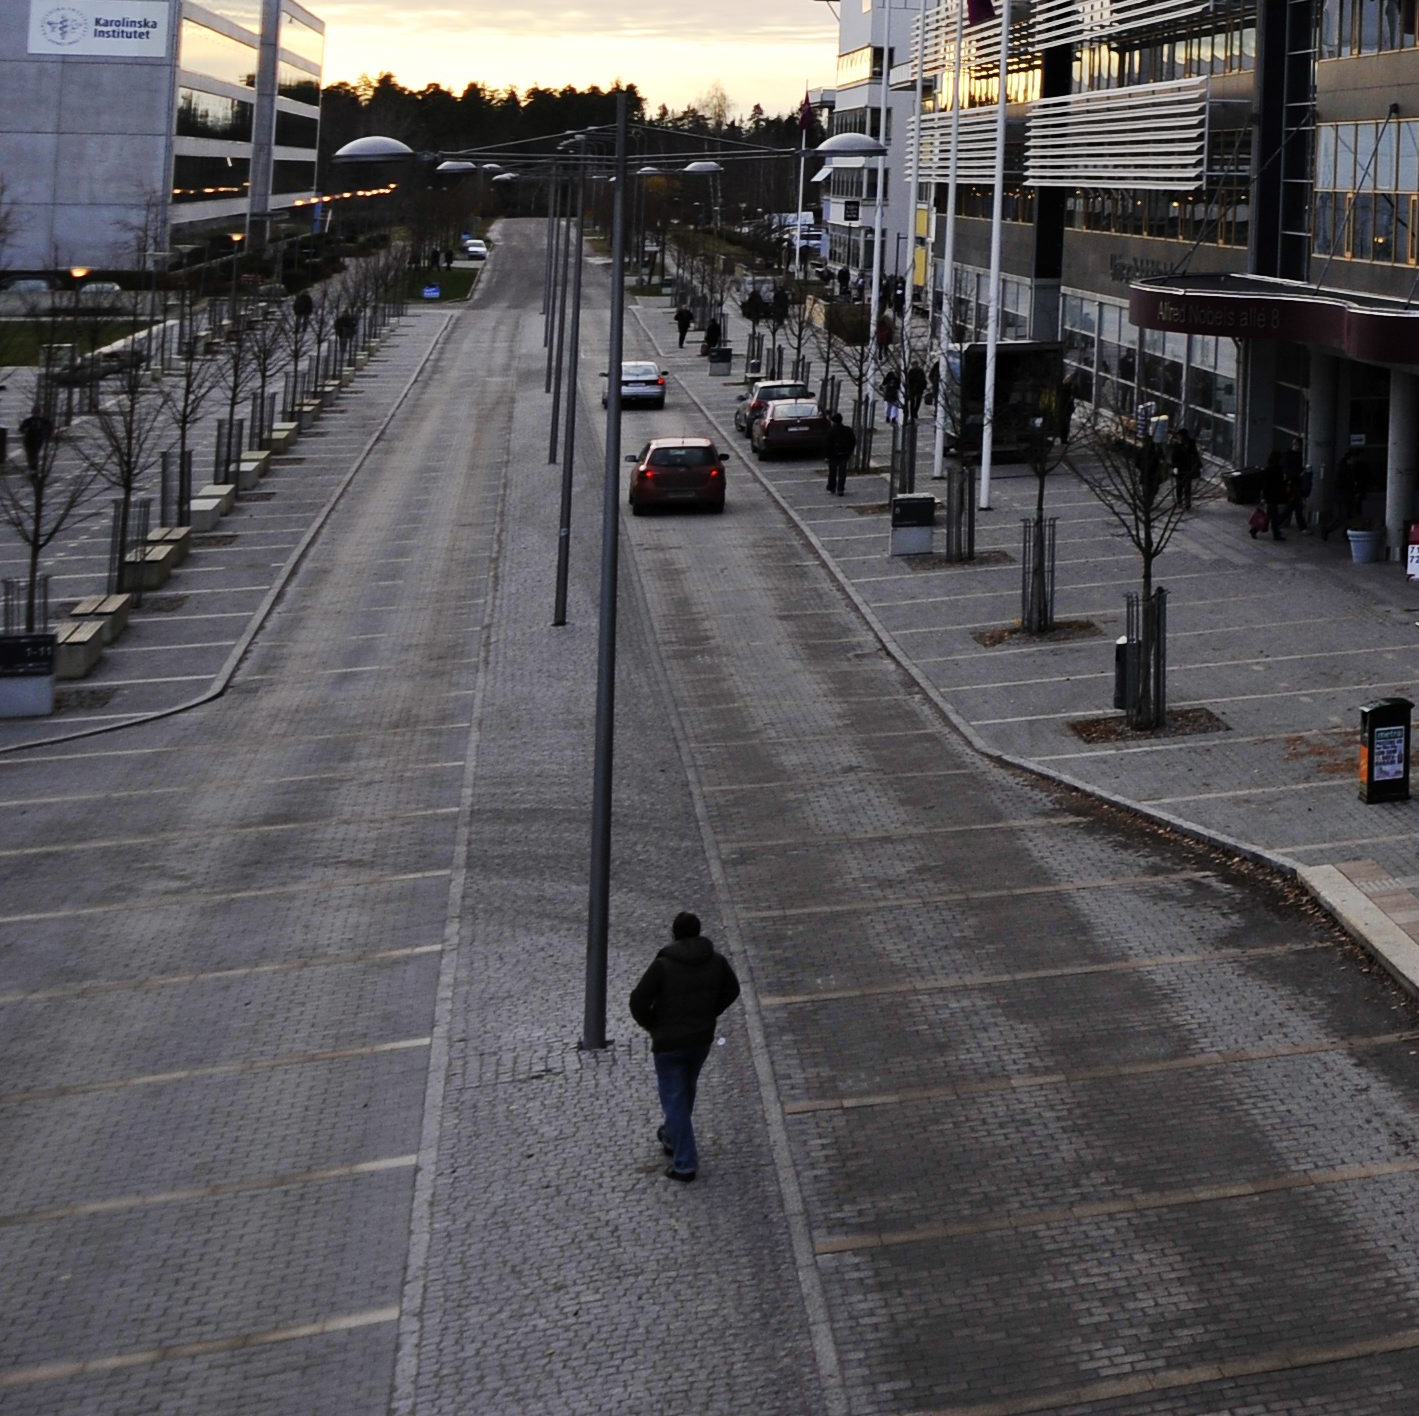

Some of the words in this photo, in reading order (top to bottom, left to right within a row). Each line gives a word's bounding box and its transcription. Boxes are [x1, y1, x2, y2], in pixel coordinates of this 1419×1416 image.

[94, 17, 157, 29] Karolinska
[93, 28, 150, 40] Institutet
[1157, 300, 1187, 323] Alfred
[1188, 304, 1235, 326] Nobels
[1239, 307, 1266, 329] allé
[1270, 309, 1280, 329] 8
